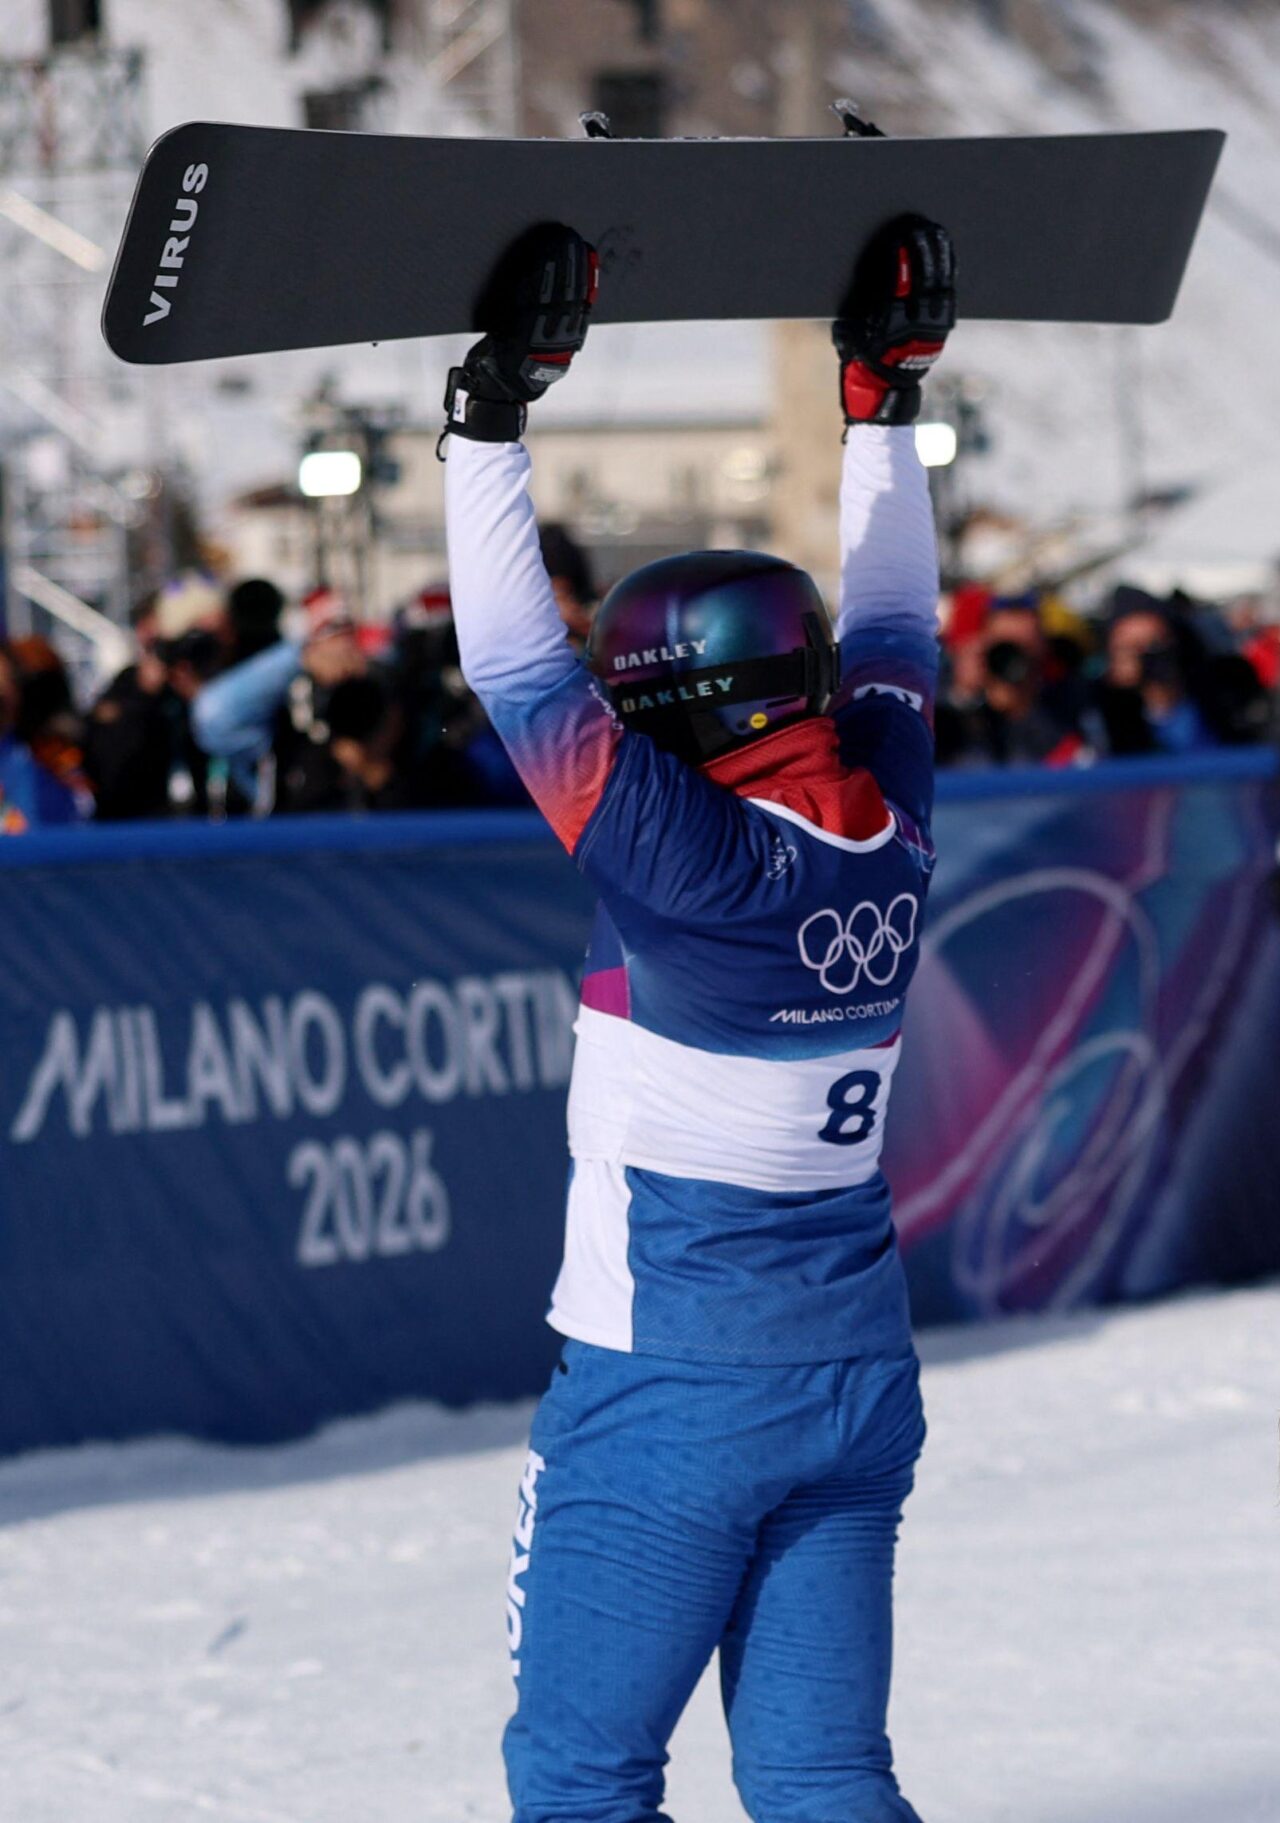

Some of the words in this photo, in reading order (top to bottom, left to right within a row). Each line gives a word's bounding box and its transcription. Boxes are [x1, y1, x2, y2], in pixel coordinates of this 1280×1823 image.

[143, 162, 209, 326] VIRUS
[613, 639, 707, 671] OAKLEY
[622, 676, 734, 713] OAKLEY
[769, 1007, 844, 1024] MILANO
[845, 998, 899, 1020] CORTIN
[11, 989, 346, 1142] MILANO
[817, 1069, 881, 1146] 8
[287, 1128, 449, 1267] 2026
